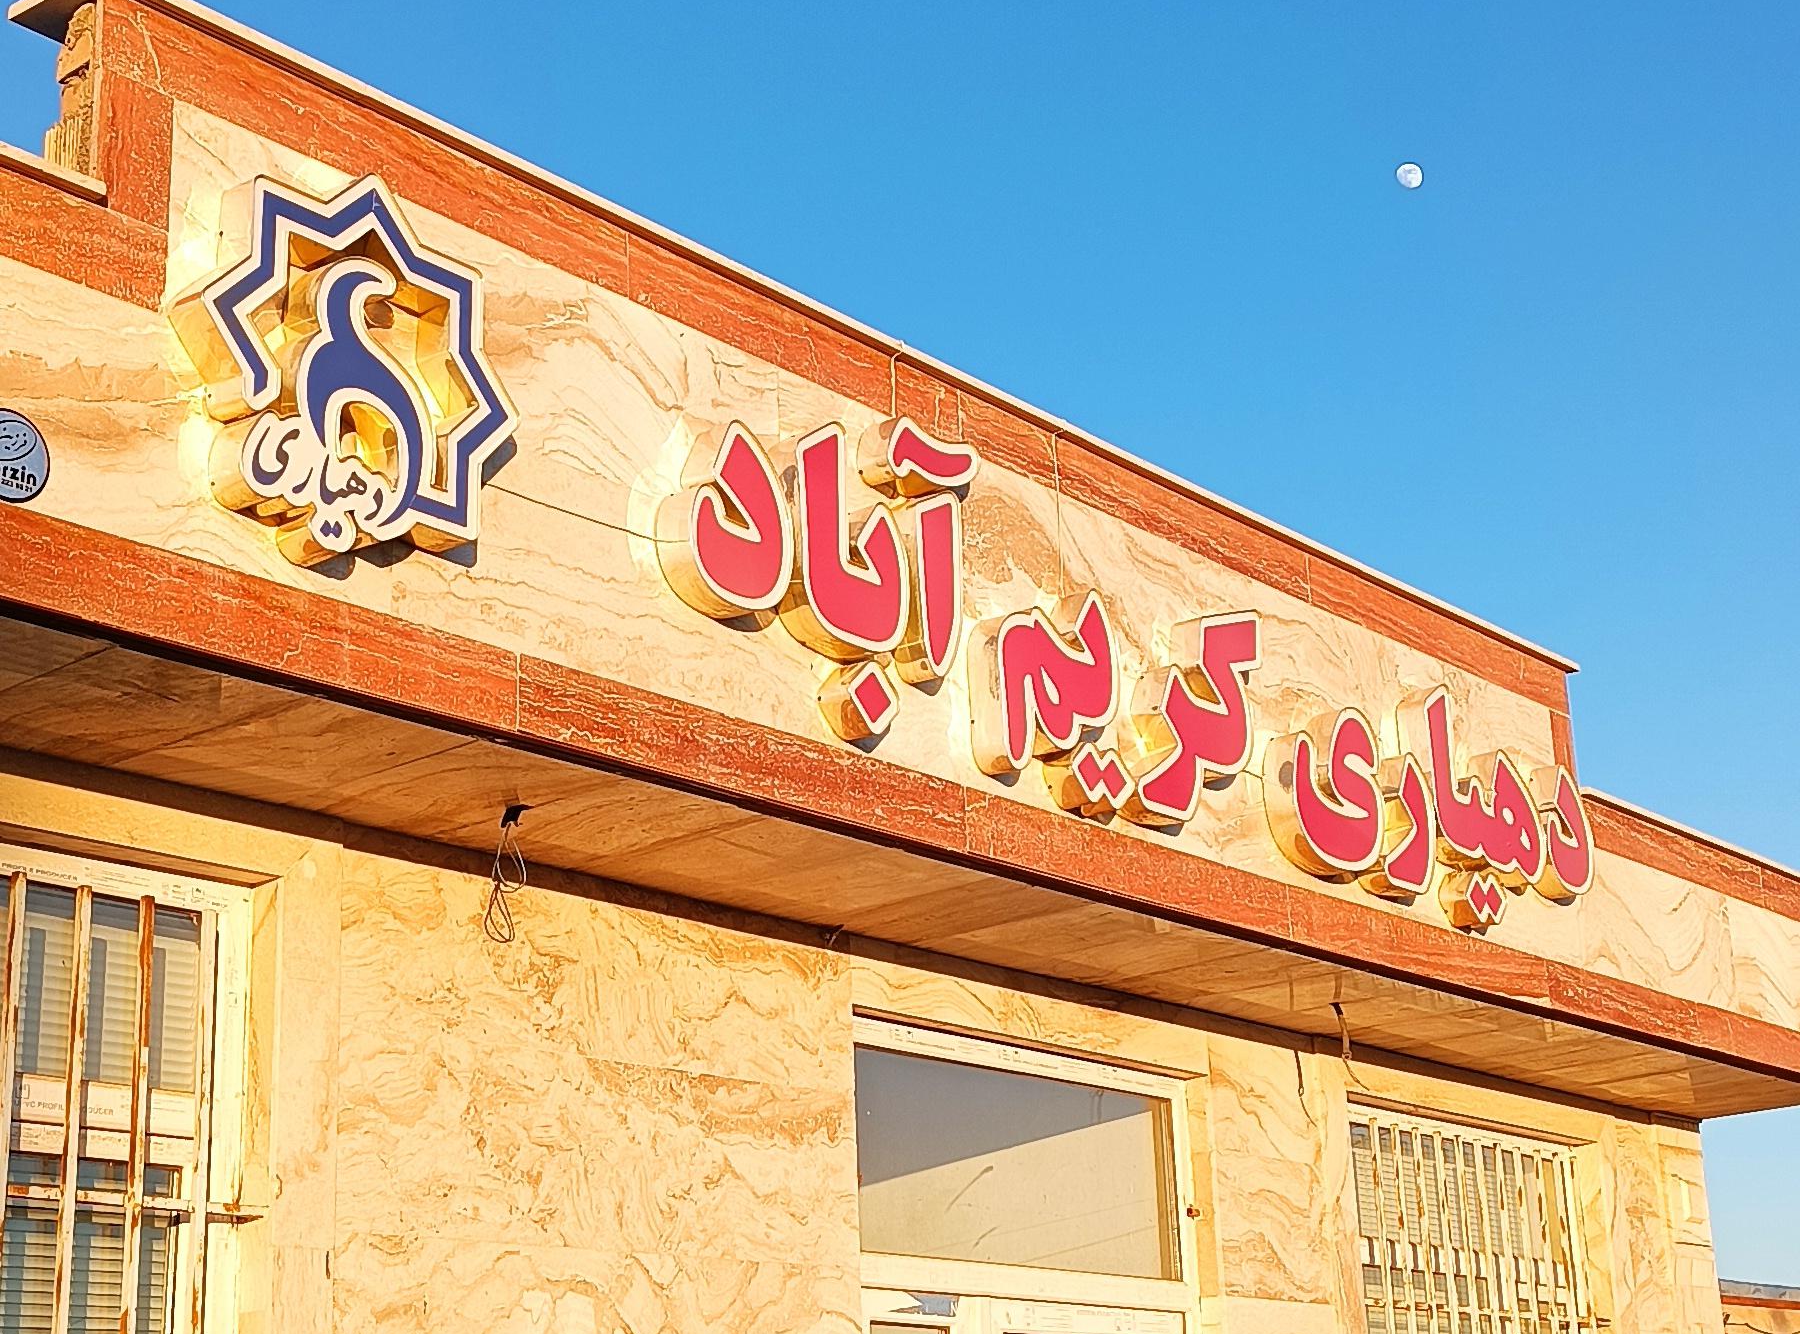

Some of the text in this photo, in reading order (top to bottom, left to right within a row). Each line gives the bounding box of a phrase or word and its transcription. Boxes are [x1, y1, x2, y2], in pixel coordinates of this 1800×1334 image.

[1, 465, 37, 486] rzin
[252, 425, 384, 539] دهیاری
[694, 425, 1591, 921] دهیاری کریم آباد
[37, 1100, 65, 1112] PROFIL
